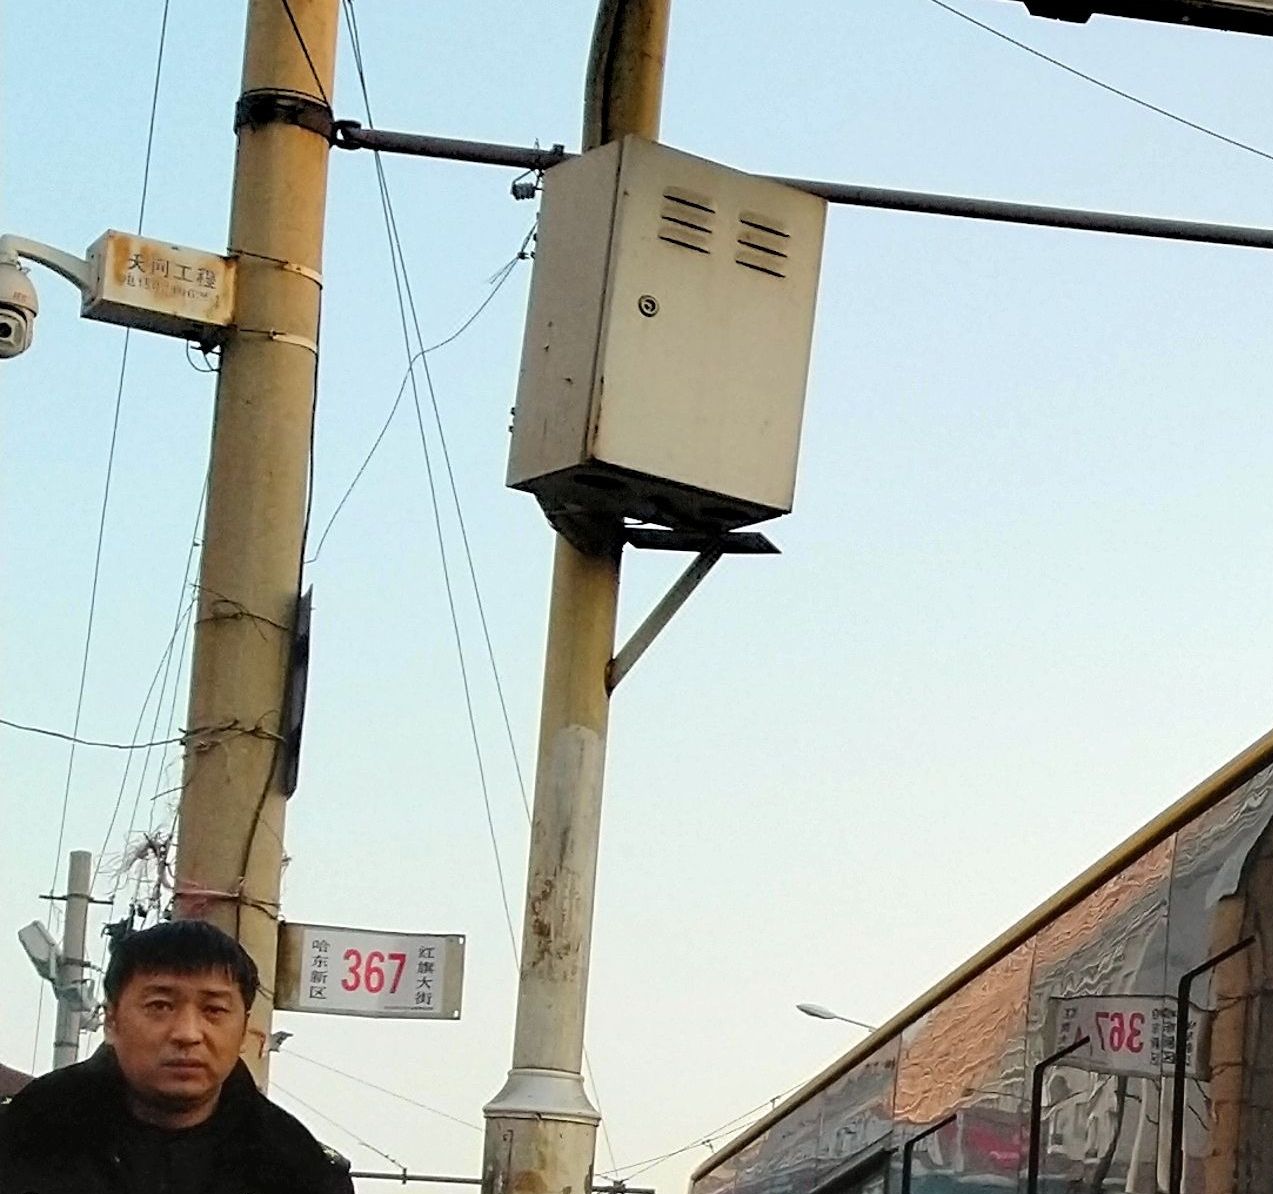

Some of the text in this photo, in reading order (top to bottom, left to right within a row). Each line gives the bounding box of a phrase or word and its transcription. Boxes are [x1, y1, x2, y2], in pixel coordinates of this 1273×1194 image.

[309, 939, 331, 1000] 哈东新区
[341, 948, 407, 994] 367
